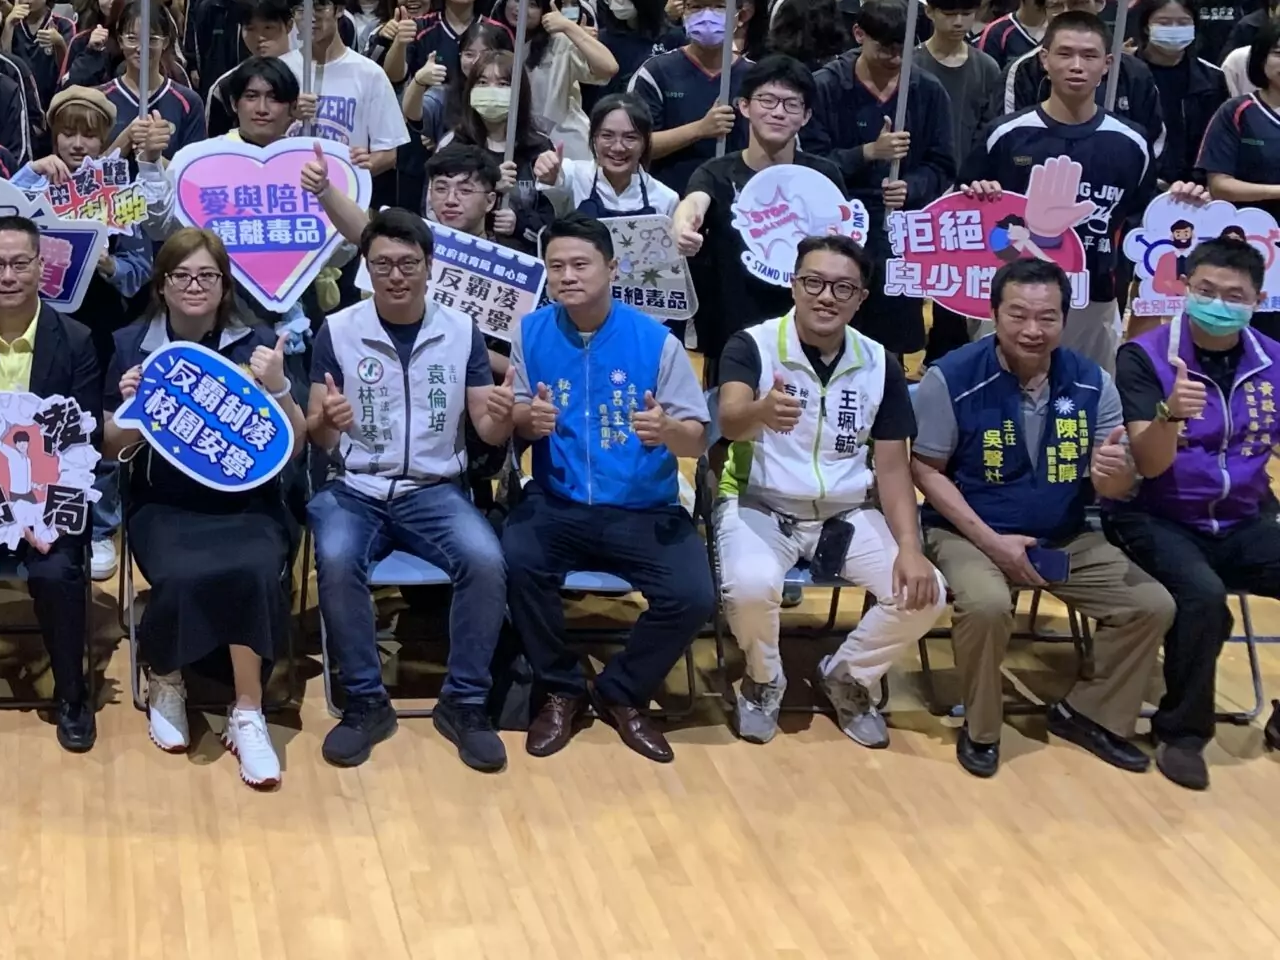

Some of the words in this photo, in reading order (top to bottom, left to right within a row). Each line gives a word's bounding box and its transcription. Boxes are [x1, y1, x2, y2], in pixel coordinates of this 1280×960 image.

[211, 217, 320, 246] 遠離毒品
[853, 211, 864, 228] DAY
[888, 209, 985, 255] 拒絕
[433, 243, 492, 272] 政府教育局
[493, 264, 528, 285] 關心您
[752, 260, 780, 280] STAND
[436, 267, 520, 311] 反霸凌
[164, 357, 276, 452] 反霸制凌
[357, 386, 378, 442] 林月琴
[427, 364, 447, 432] 袁倫培
[143, 387, 255, 481] 校園安寧
[1003, 419, 1016, 446] 主任
